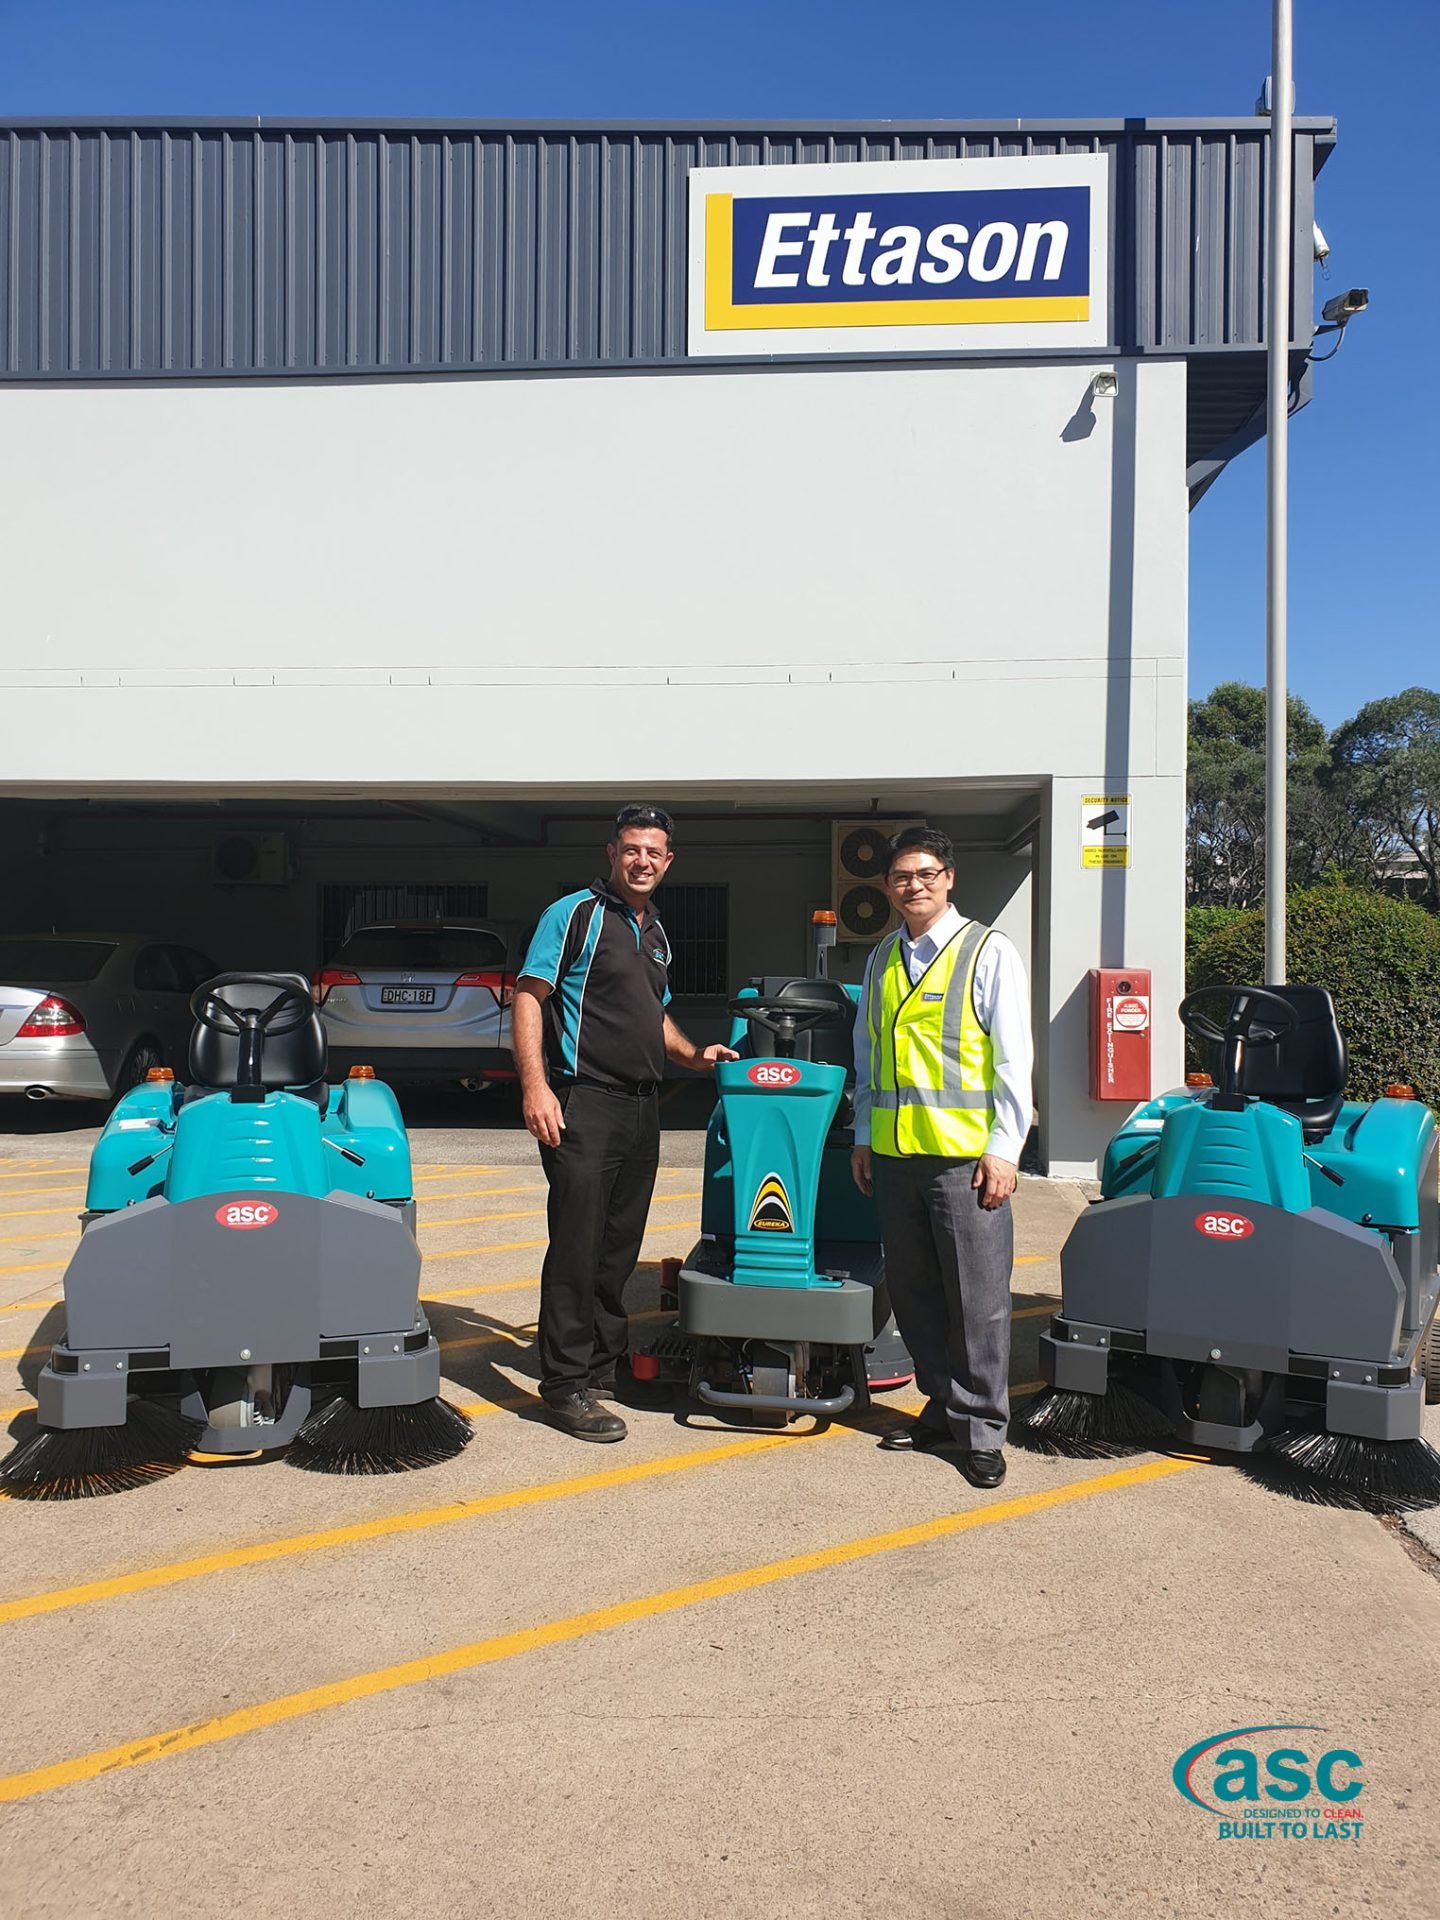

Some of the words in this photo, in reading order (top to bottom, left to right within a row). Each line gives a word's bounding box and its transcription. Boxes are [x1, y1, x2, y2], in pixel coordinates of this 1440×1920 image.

[753, 211, 1069, 289] Ettason
[1106, 1022, 1115, 1084] EXTINGUISHER
[756, 1066, 793, 1082] asc
[226, 1206, 269, 1223] asc
[1204, 1215, 1245, 1234] asc
